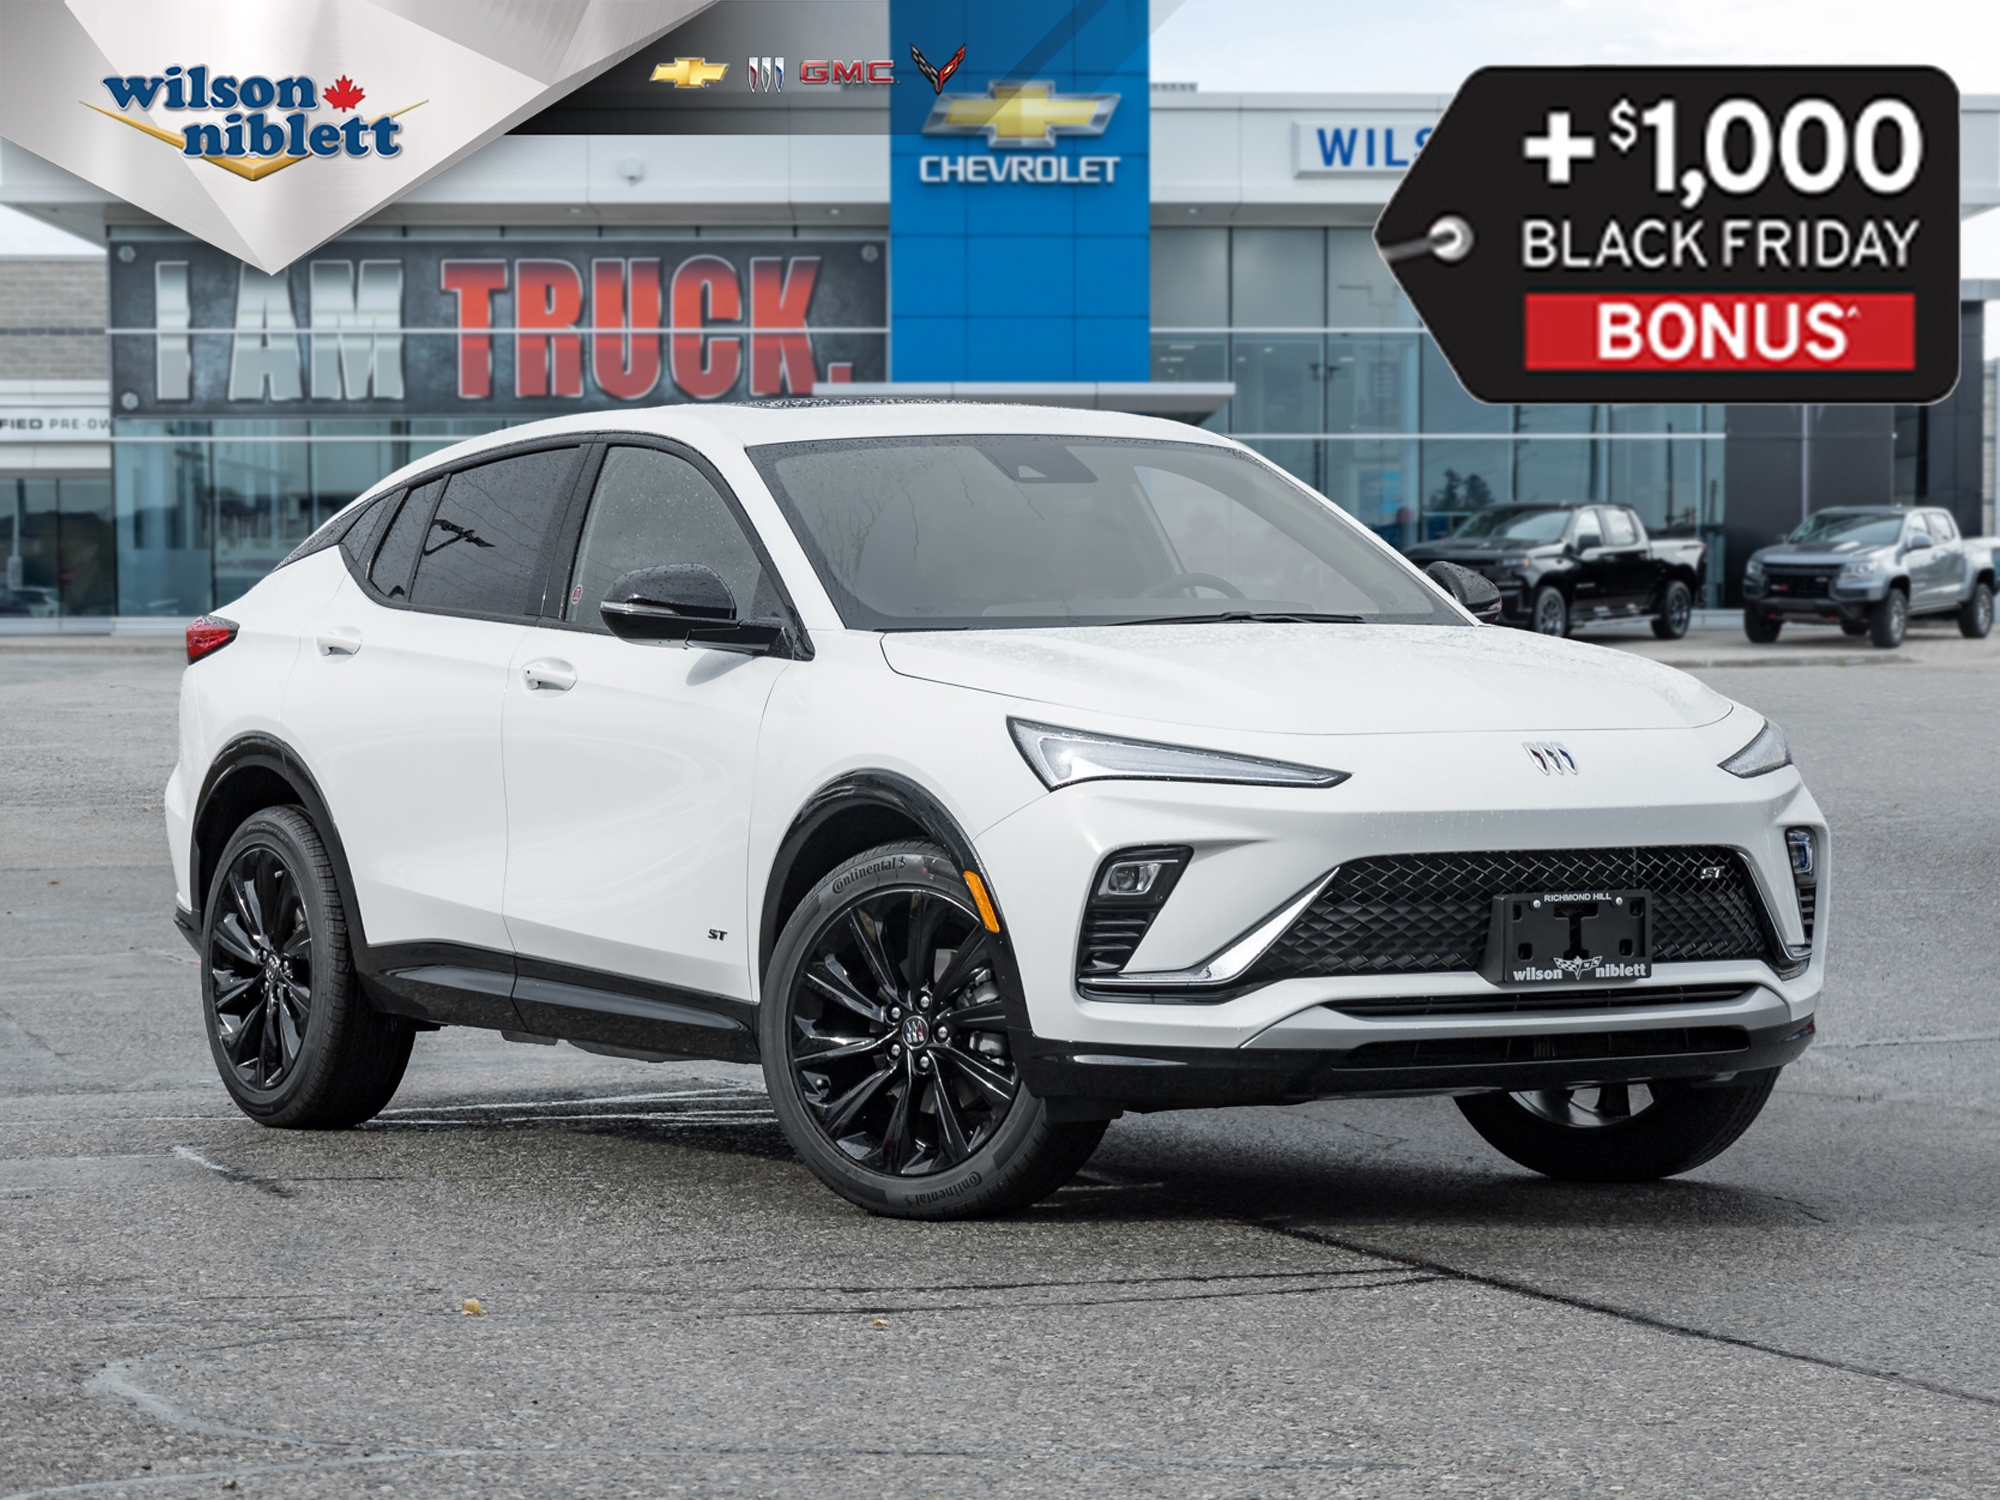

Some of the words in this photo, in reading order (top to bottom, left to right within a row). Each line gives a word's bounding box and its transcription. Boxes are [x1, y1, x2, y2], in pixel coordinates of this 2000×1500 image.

[919, 156, 1120, 184] CHEVROLET
[156, 260, 192, 400] I
[229, 260, 404, 400] AM
[831, 857, 897, 894] Continental
[1544, 893, 1591, 902] RICHMOND
[1593, 892, 1612, 900] HILL
[708, 928, 728, 941] ST
[1513, 966, 1563, 982] wilson
[1595, 963, 1646, 978] niblett
